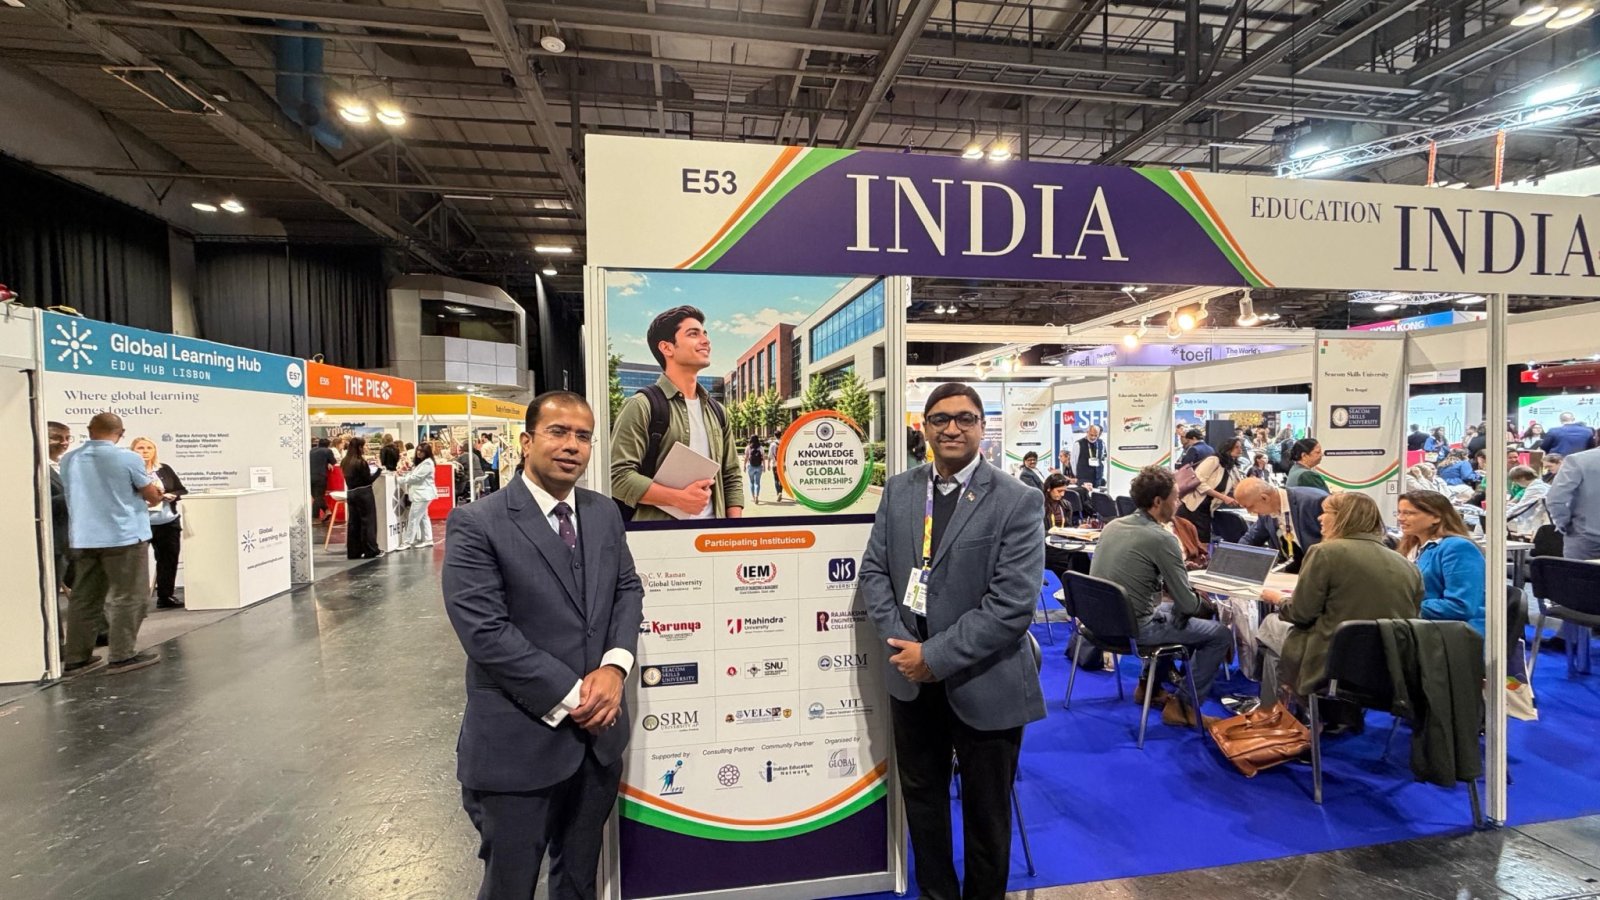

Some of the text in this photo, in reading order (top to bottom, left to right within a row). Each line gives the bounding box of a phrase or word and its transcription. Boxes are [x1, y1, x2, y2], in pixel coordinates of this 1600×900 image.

[682, 168, 738, 195] E53
[1250, 196, 1383, 224] EDUCATION
[846, 173, 1130, 262] INDIA
[1393, 205, 1600, 278] INDIA
[110, 333, 262, 373] Global Learning Hub
[1180, 347, 1213, 362] toefl
[111, 359, 211, 381] EDU HUB LISBON
[288, 371, 301, 380] E57
[343, 374, 381, 398] THE PIE
[64, 390, 200, 404] Where global learning
[64, 404, 163, 418] comes together.
[798, 450, 854, 458] KNOWLEDGE
[806, 467, 846, 476] GLOBAL
[800, 477, 853, 485] PARTNERSHIPS
[259, 526, 273, 534] Global
[704, 536, 806, 548] Participating Institutions
[743, 565, 770, 578] IEM
[652, 620, 701, 634] Karunya
[744, 616, 784, 625] Mahindra
[764, 662, 783, 670] SNU
[833, 653, 868, 668] SRM
[840, 698, 860, 708] VIT
[660, 710, 699, 726] SRM
[743, 708, 772, 718] VELS
[651, 752, 681, 760] Supported
[702, 748, 732, 756] Consulting
[828, 758, 857, 768] GLOBAL
